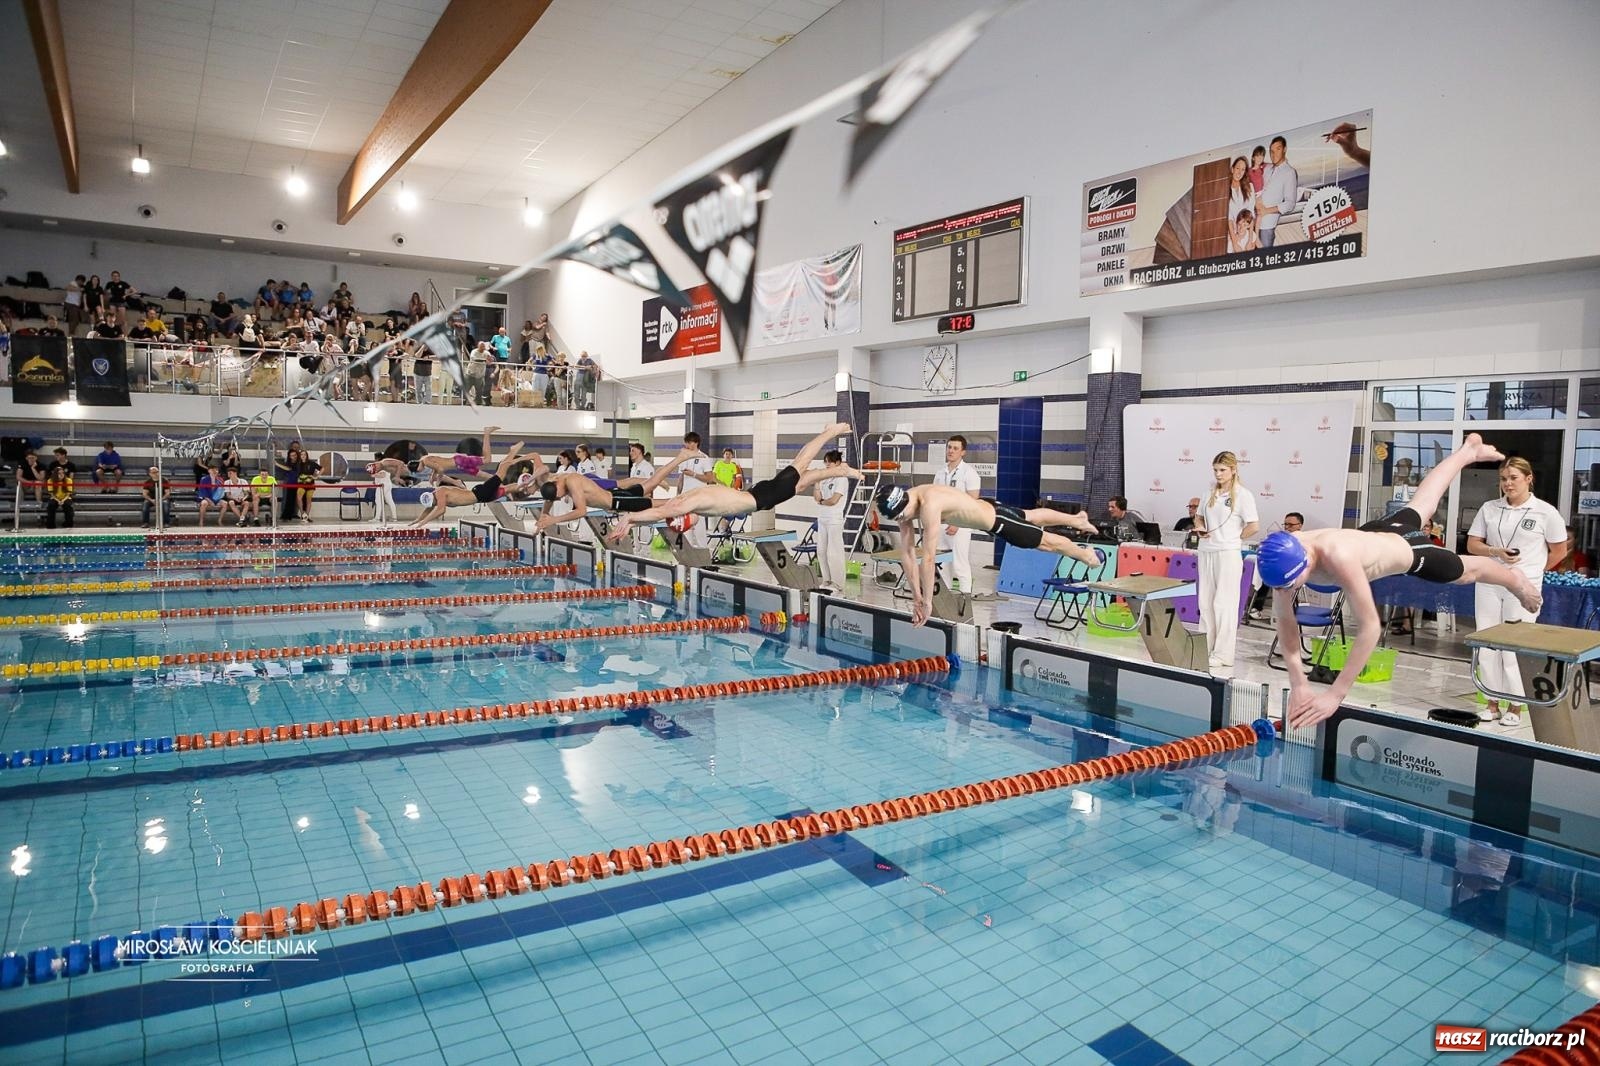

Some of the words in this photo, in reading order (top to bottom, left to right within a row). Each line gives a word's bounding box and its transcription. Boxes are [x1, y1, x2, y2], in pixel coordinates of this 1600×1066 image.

[1309, 193, 1346, 218] -15%
[1314, 215, 1352, 238] MONTAŻEM
[1098, 227, 1126, 241] BRAMY
[958, 247, 964, 256] 5.
[1101, 243, 1125, 256] DRZWI
[957, 264, 964, 273] 6.
[1097, 259, 1124, 272] PANELE
[1134, 265, 1182, 285] RACIBÓRZ
[1186, 267, 1196, 276] ul.
[1198, 260, 1246, 275] Głubczycka
[1249, 256, 1262, 268] 13,
[1266, 254, 1281, 266] tel:
[1284, 250, 1296, 262] 32
[1298, 249, 1302, 262] /
[1304, 247, 1324, 260] 415
[1326, 244, 1339, 256] 25
[1342, 242, 1356, 254] 00
[896, 276, 903, 286] 2.
[956, 281, 964, 290] 7.
[1104, 275, 1124, 288] OKNA
[896, 292, 902, 300] 3.
[956, 298, 963, 306] 8.
[680, 308, 718, 330] informacji
[662, 322, 672, 334] rtk
[600, 522, 607, 536] 3
[676, 532, 683, 550] 4
[777, 550, 786, 568] 5
[1165, 608, 1175, 638] 7
[1038, 666, 1066, 680] Colorado
[1532, 676, 1557, 707] 8
[1572, 670, 1582, 710] 8
[1384, 748, 1434, 768] Colorado
[1385, 758, 1402, 767] TIME
